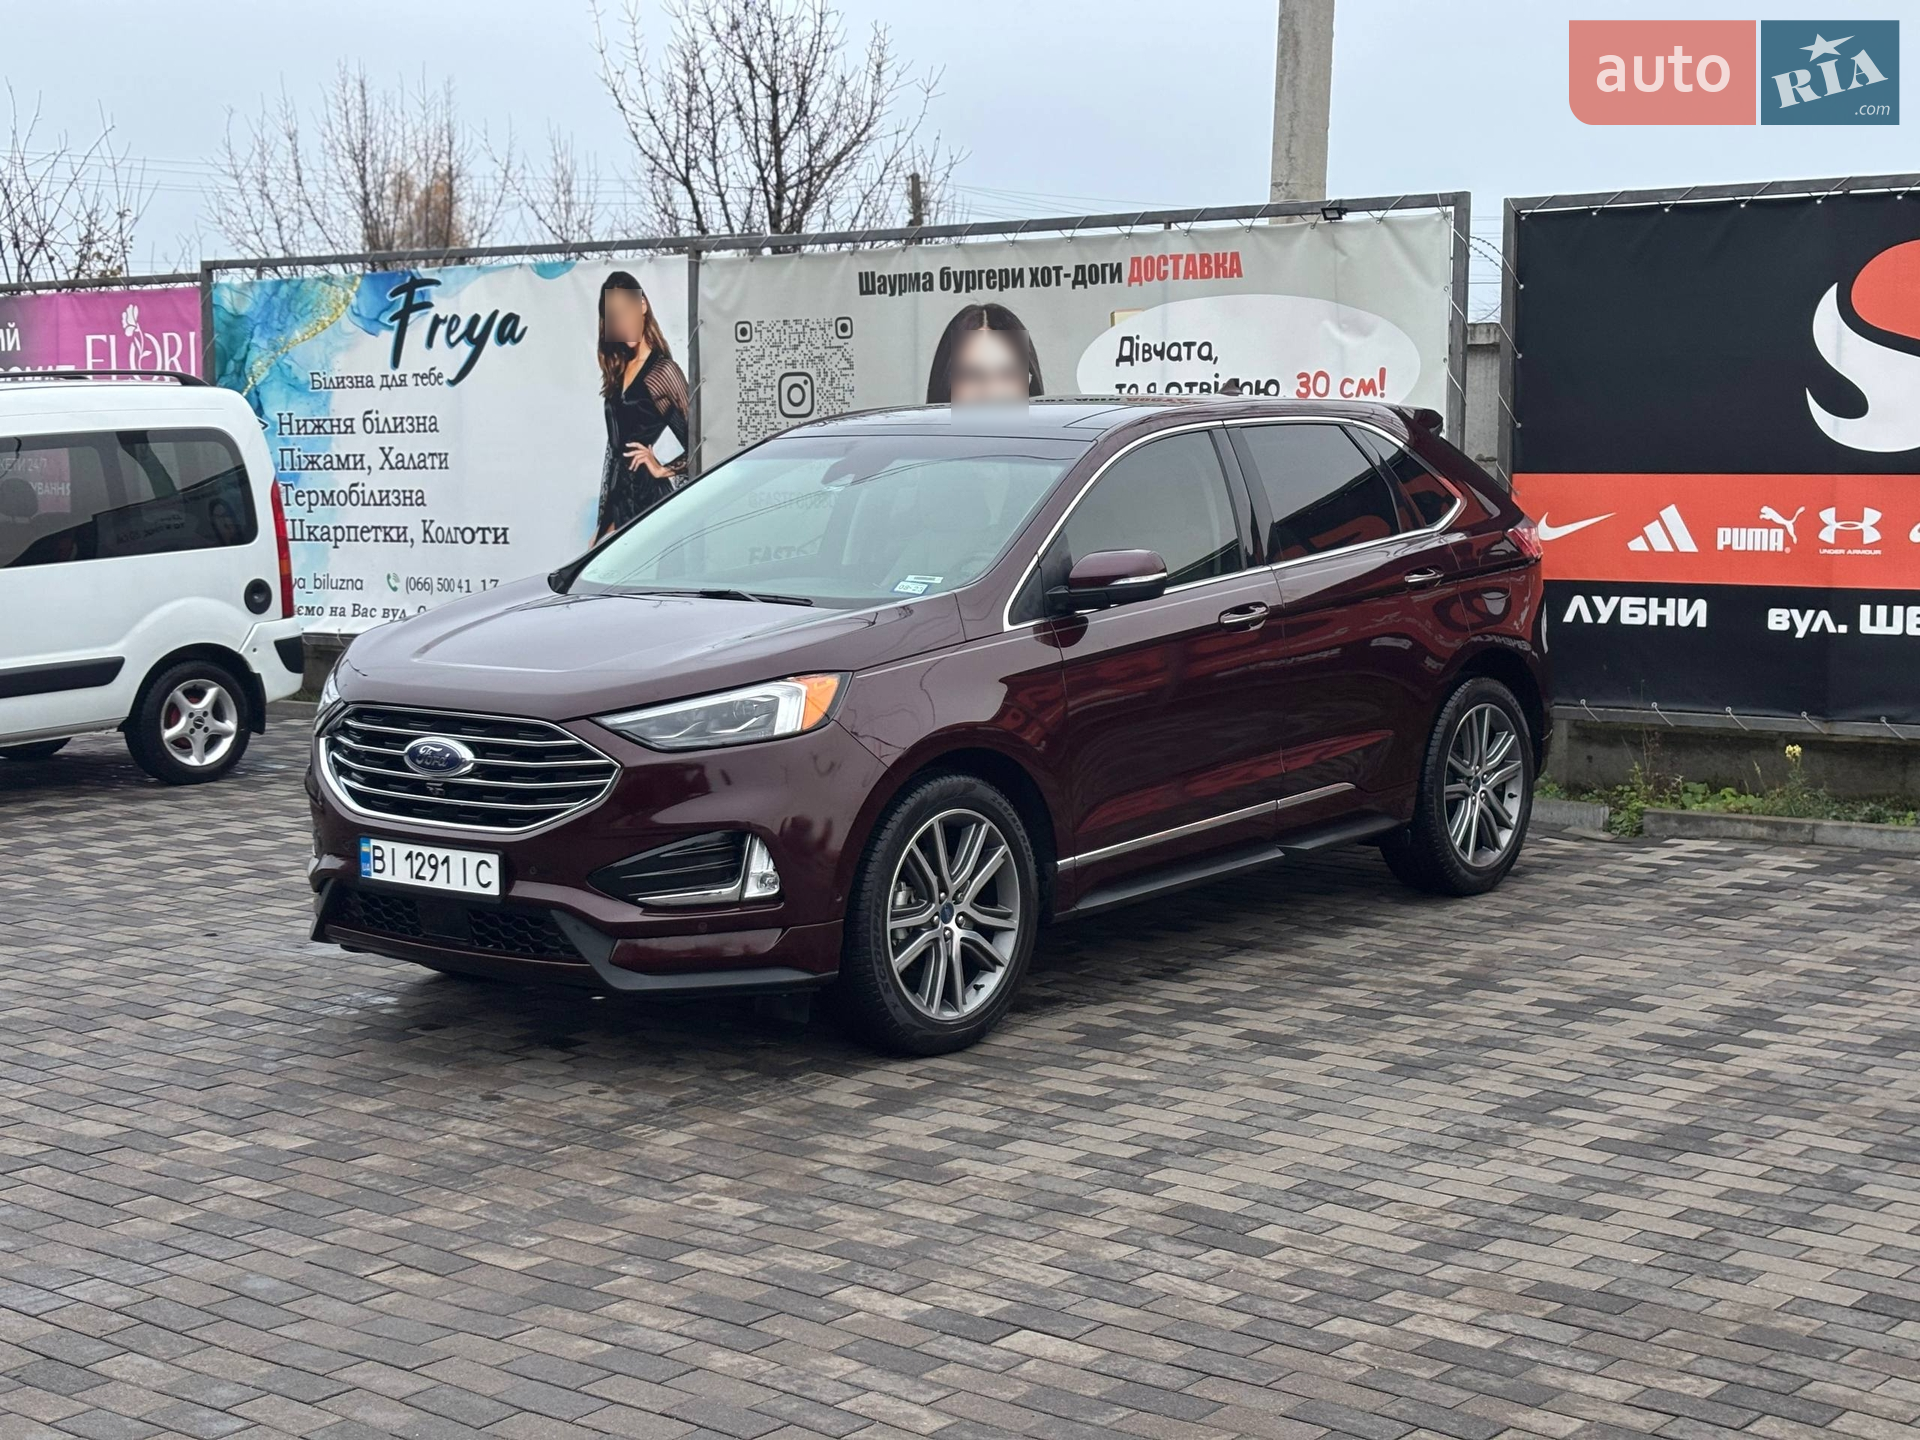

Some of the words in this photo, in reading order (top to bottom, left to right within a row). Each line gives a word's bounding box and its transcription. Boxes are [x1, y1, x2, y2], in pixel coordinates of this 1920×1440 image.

[858, 269, 935, 296] Шаурма
[939, 265, 1025, 293] бургери
[1029, 260, 1123, 289] хот-доги
[1127, 251, 1243, 287] ДОСТАВКА
[387, 275, 528, 386] Freya
[1115, 335, 1219, 367] Дівчата,
[310, 371, 376, 390] Білизна
[380, 373, 408, 391] для
[412, 366, 444, 387] тебе
[1296, 370, 1330, 399] 30
[1339, 367, 1387, 399] см!
[277, 412, 356, 436] Нижня
[362, 410, 440, 434] білизна
[279, 447, 373, 475] Піжами,
[378, 446, 450, 471] Халати
[281, 483, 427, 512] Термобілизна
[285, 518, 415, 548] Шкарпетки,
[421, 519, 511, 545] Колготи
[1717, 527, 1784, 552] PUMA
[405, 577, 434, 595] (066)
[329, 606, 347, 618] на
[351, 603, 377, 618] Вас
[1562, 594, 1708, 628] ЛУБНИ
[1767, 608, 1848, 638] вул.
[415, 745, 451, 767] Ford
[405, 850, 450, 884] 1291
